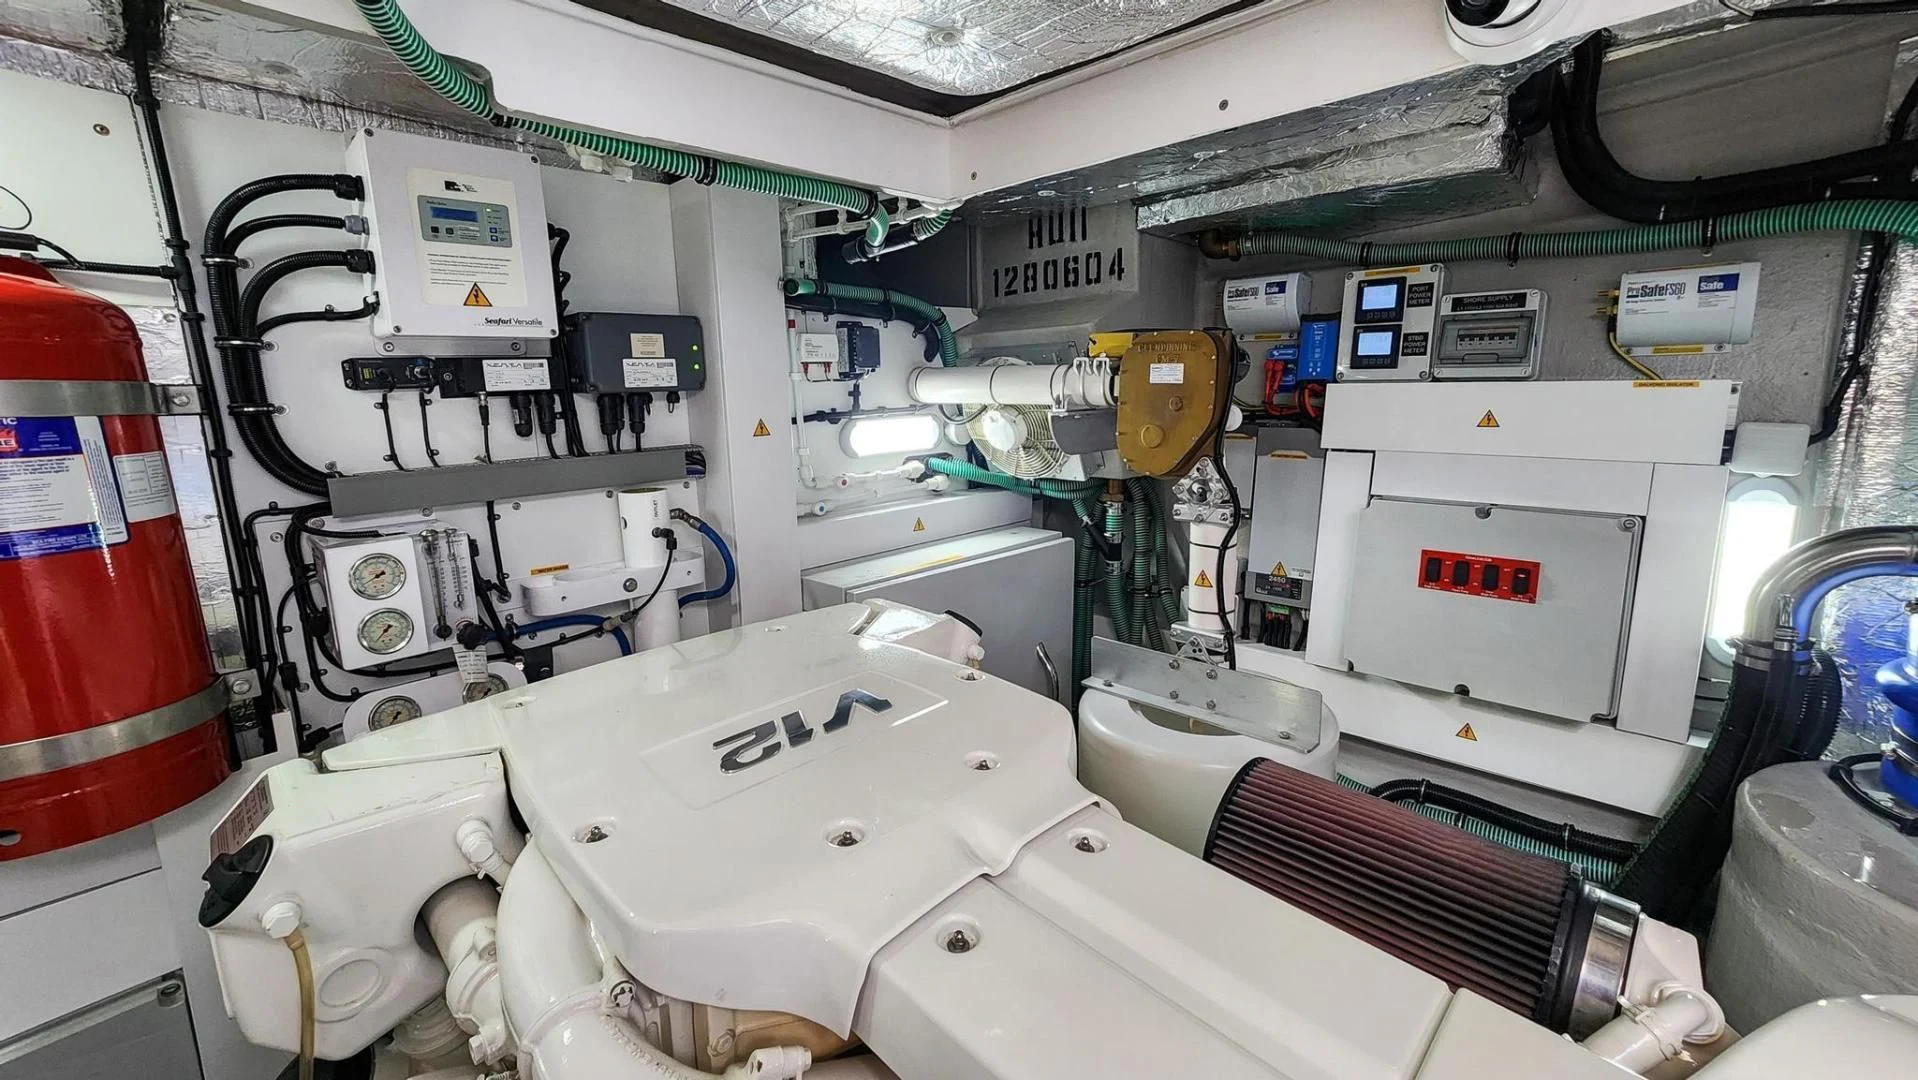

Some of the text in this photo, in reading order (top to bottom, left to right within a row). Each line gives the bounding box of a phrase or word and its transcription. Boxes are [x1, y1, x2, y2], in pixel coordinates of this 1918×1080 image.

[992, 247, 1125, 298] 1280604
[512, 317, 543, 327] Versatile
[712, 688, 892, 774] V12
